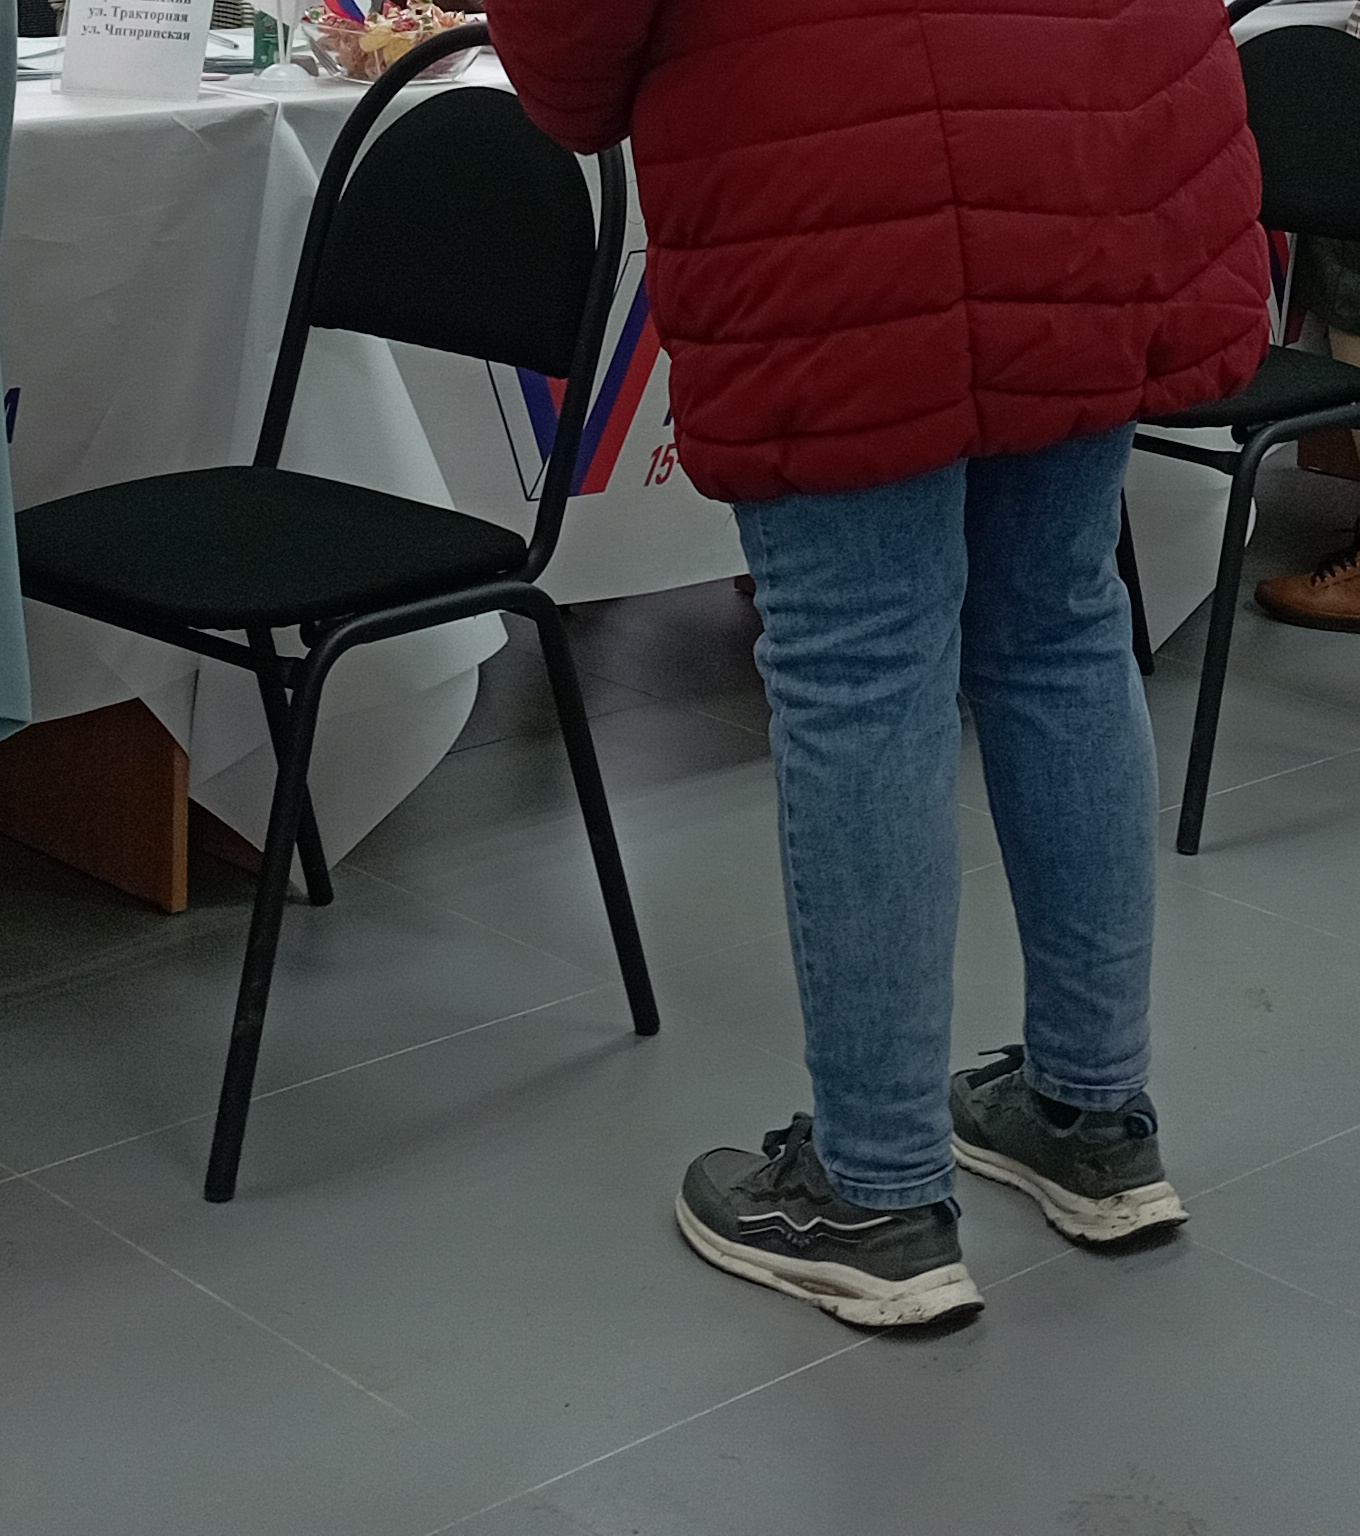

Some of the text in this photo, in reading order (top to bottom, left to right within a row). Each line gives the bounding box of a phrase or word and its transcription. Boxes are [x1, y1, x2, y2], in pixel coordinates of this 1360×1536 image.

[87, 5, 189, 23] ул. Тракторная
[80, 23, 191, 41] ул. Чигиринская
